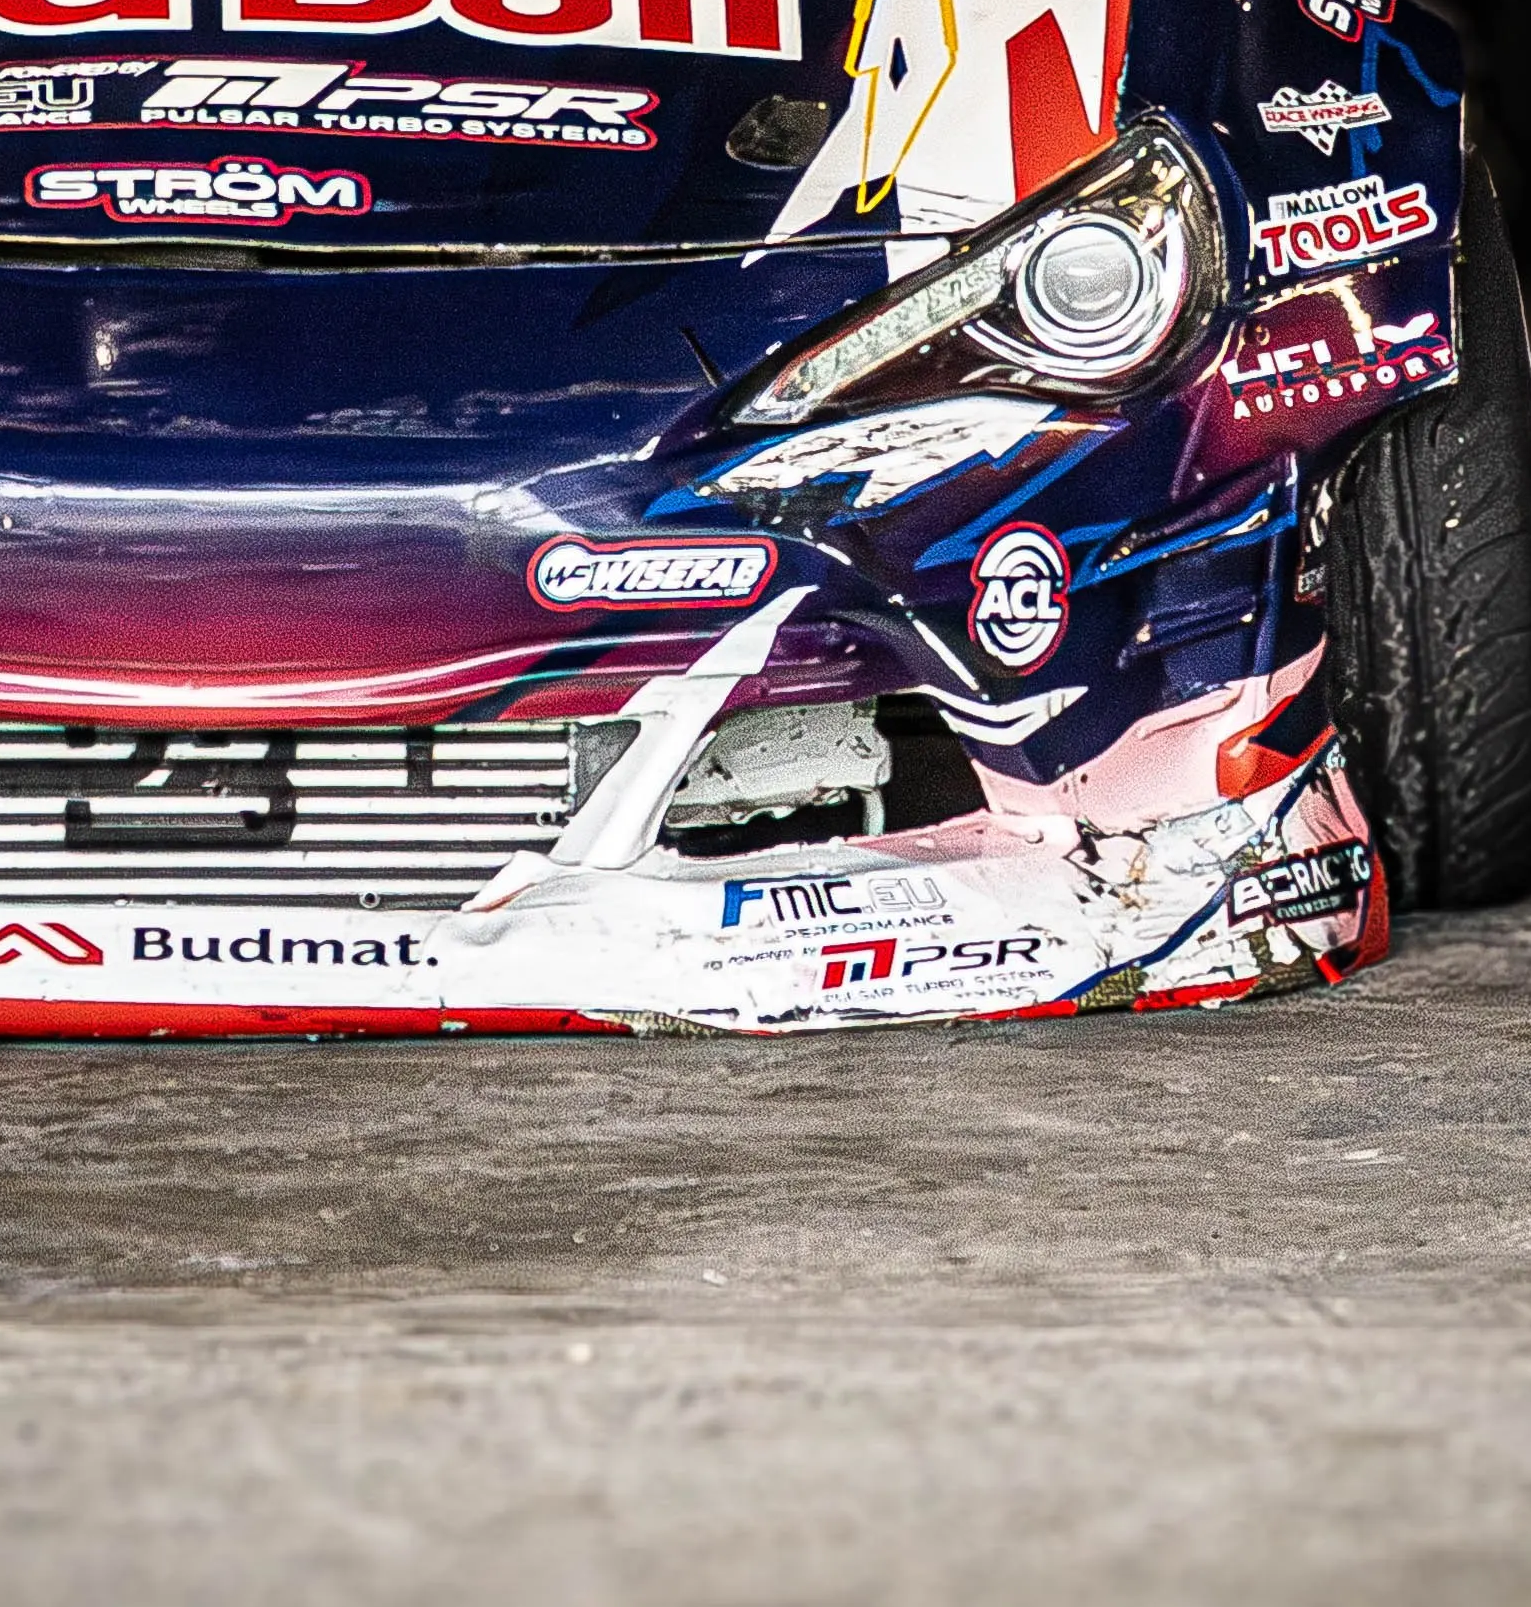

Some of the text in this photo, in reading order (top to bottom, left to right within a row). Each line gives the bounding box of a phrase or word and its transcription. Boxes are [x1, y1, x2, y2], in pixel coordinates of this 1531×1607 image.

[140, 108, 647, 145] PULSAR TURBO SYSTEMS
[39, 163, 358, 207] STRÖM
[1286, 180, 1380, 218] MALLOW
[118, 198, 279, 218] WHEELS
[1260, 189, 1431, 268] TOOLS
[1233, 347, 1451, 420] AUTOSPORT
[589, 556, 766, 592] WISEFAB
[132, 926, 440, 968] Budmat.
